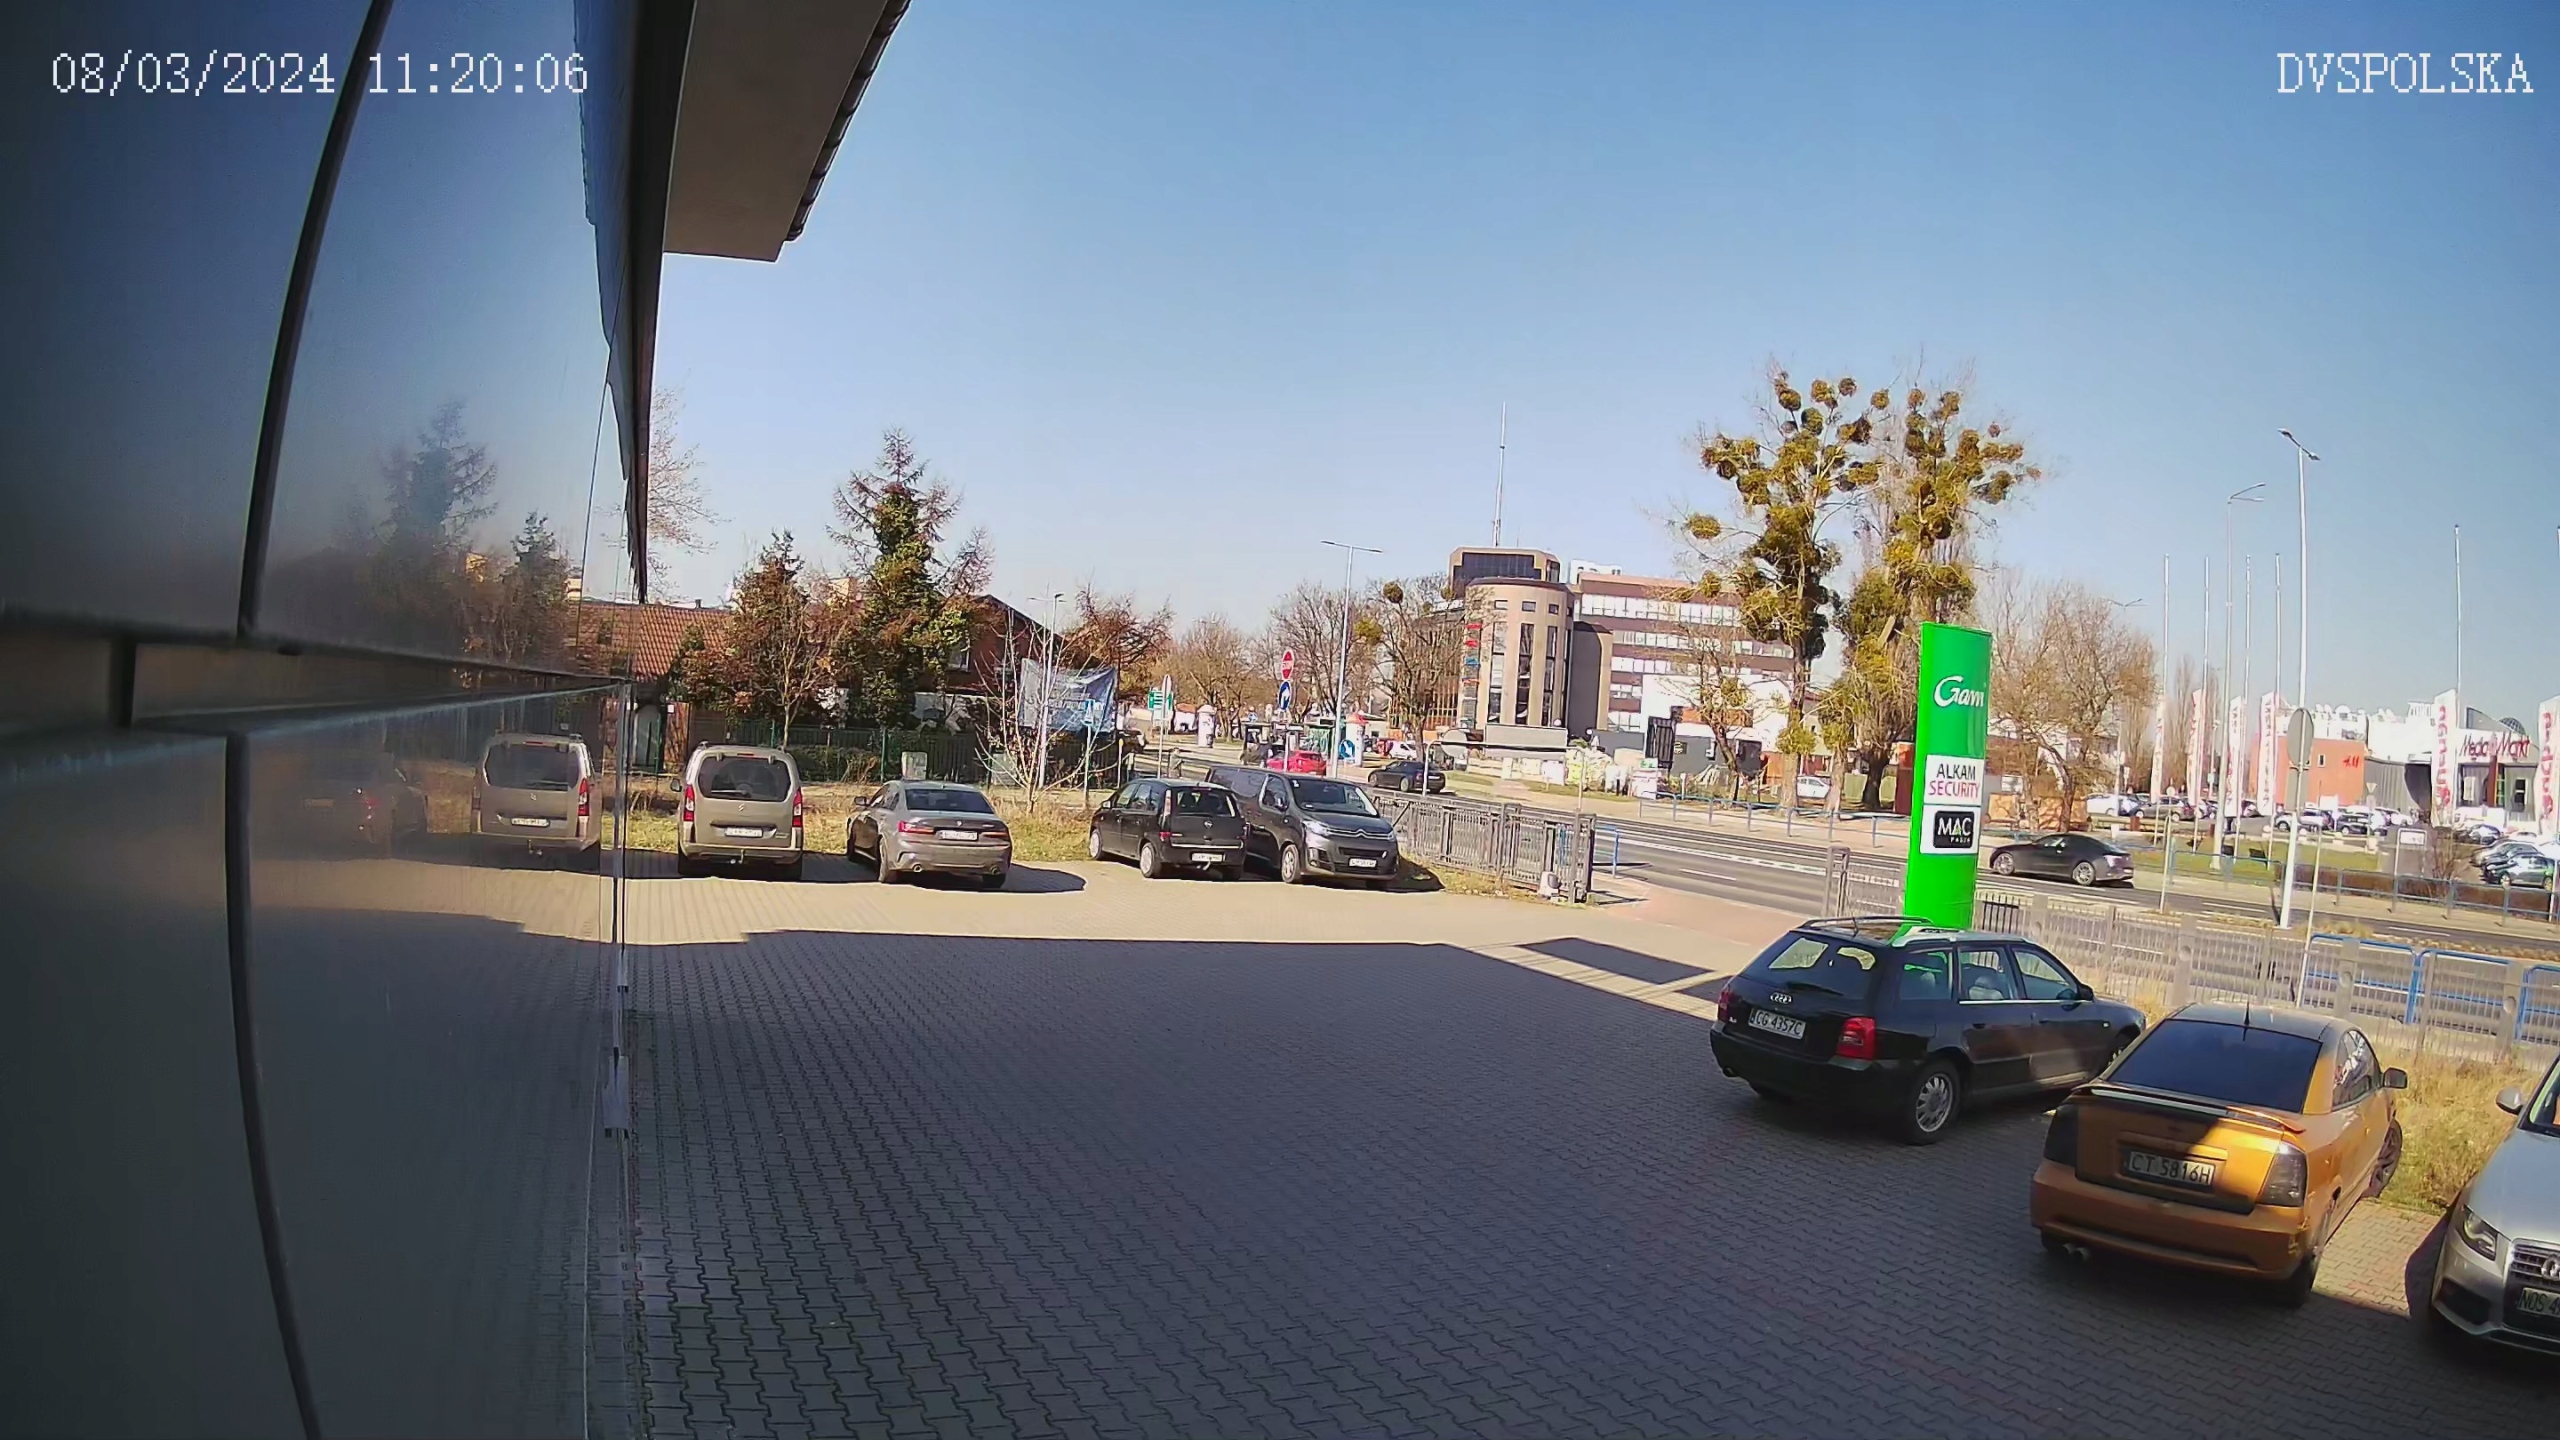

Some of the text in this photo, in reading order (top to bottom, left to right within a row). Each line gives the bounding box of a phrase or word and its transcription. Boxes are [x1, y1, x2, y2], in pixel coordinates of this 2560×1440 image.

[1936, 763, 1976, 780] ALKAM
[1928, 780, 1980, 798] SECURITY
[1937, 817, 1972, 836] MAC
[1756, 1011, 1803, 1035] CG 4357C
[2132, 1153, 2211, 1185] CT 5816H
[2519, 1289, 2548, 1312] NOS
